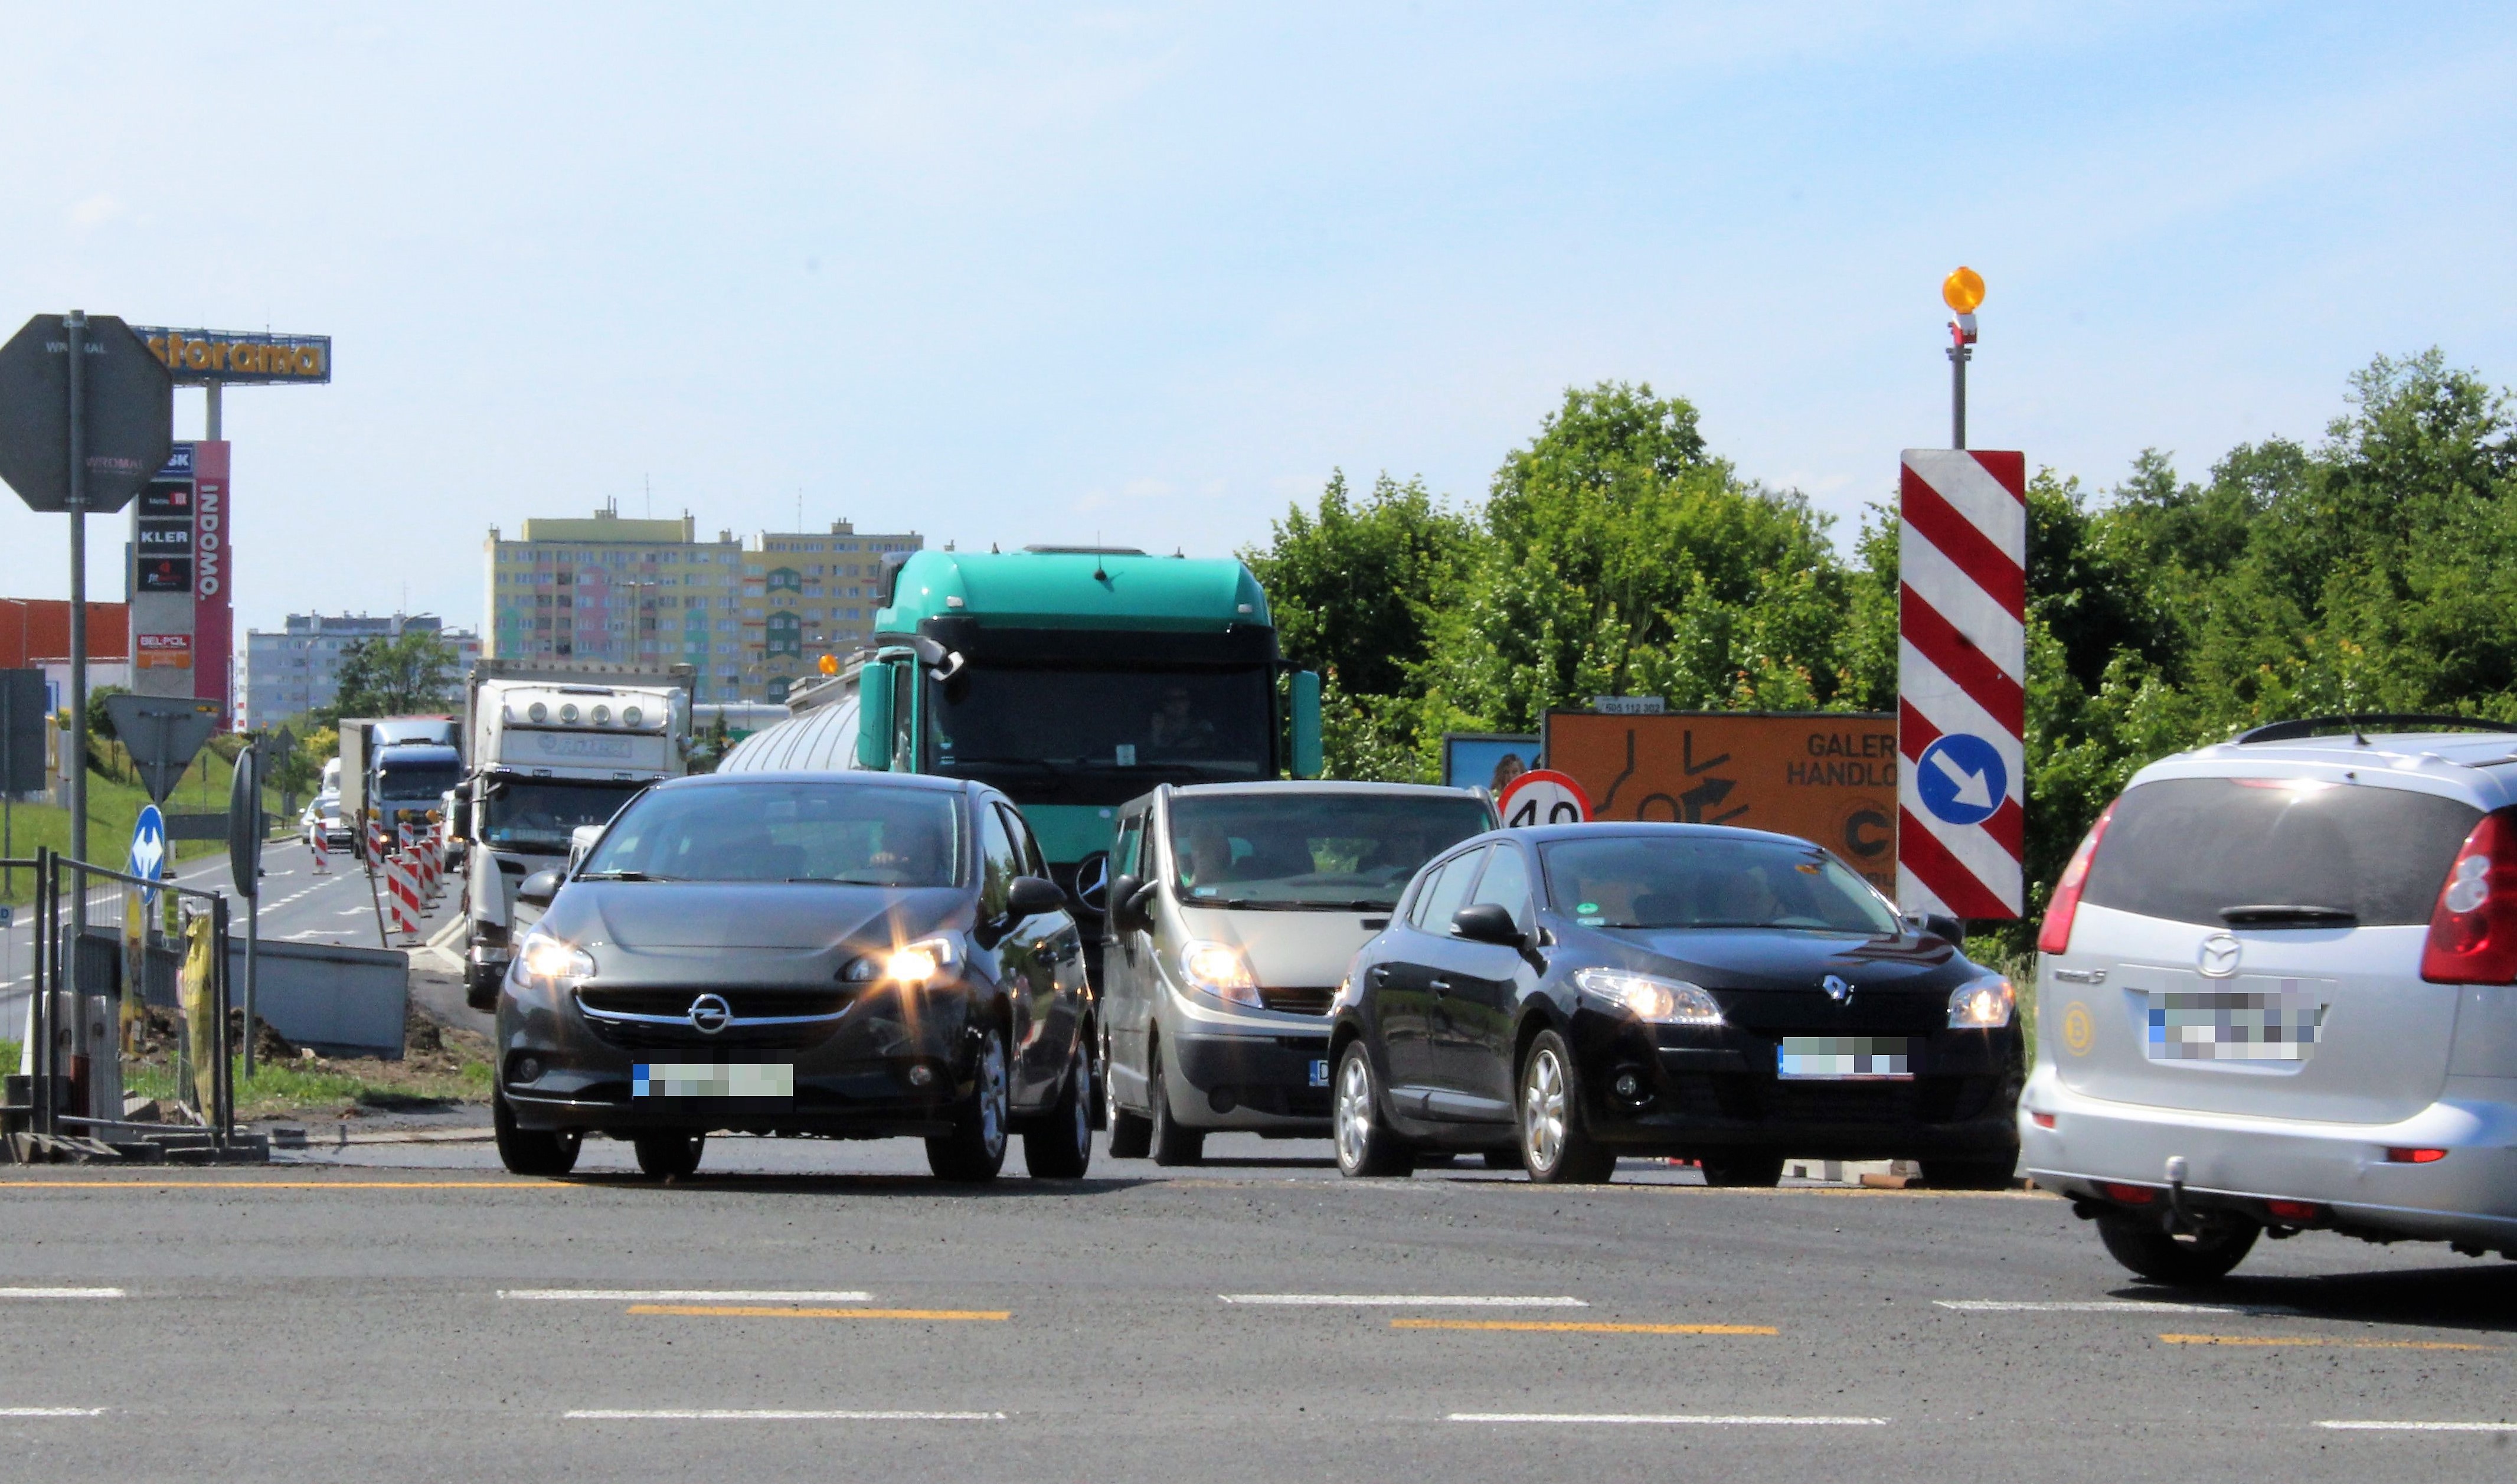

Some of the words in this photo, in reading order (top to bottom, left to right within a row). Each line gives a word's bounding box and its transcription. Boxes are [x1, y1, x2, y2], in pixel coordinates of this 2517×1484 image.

[148, 333, 321, 375] storama
[141, 531, 188, 542] KLER
[1807, 734, 1897, 758] GALER
[1509, 799, 1578, 828] 40
